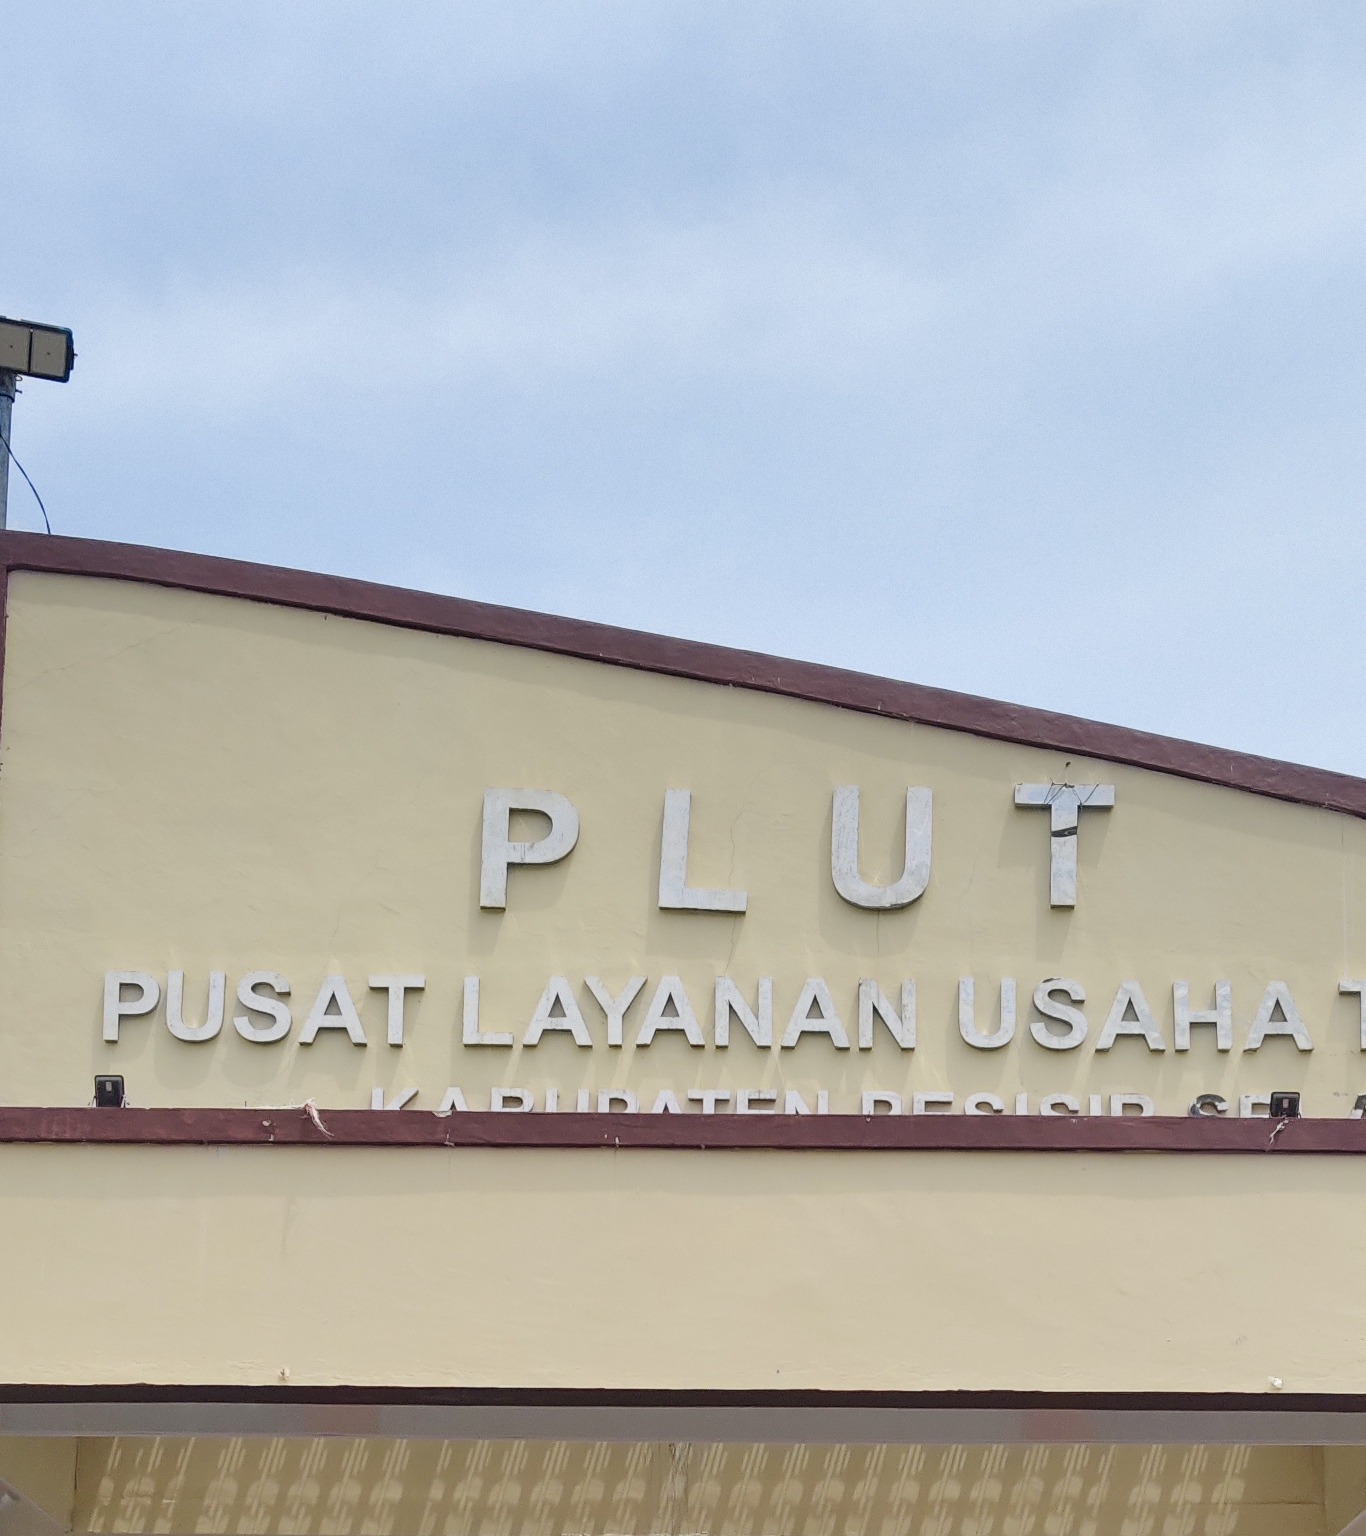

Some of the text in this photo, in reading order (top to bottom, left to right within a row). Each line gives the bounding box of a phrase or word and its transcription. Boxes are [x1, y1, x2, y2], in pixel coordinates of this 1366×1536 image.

[102, 970, 426, 1047] PUSAT
[462, 976, 918, 1050] LAYANAN
[957, 978, 1314, 1053] USAHA
